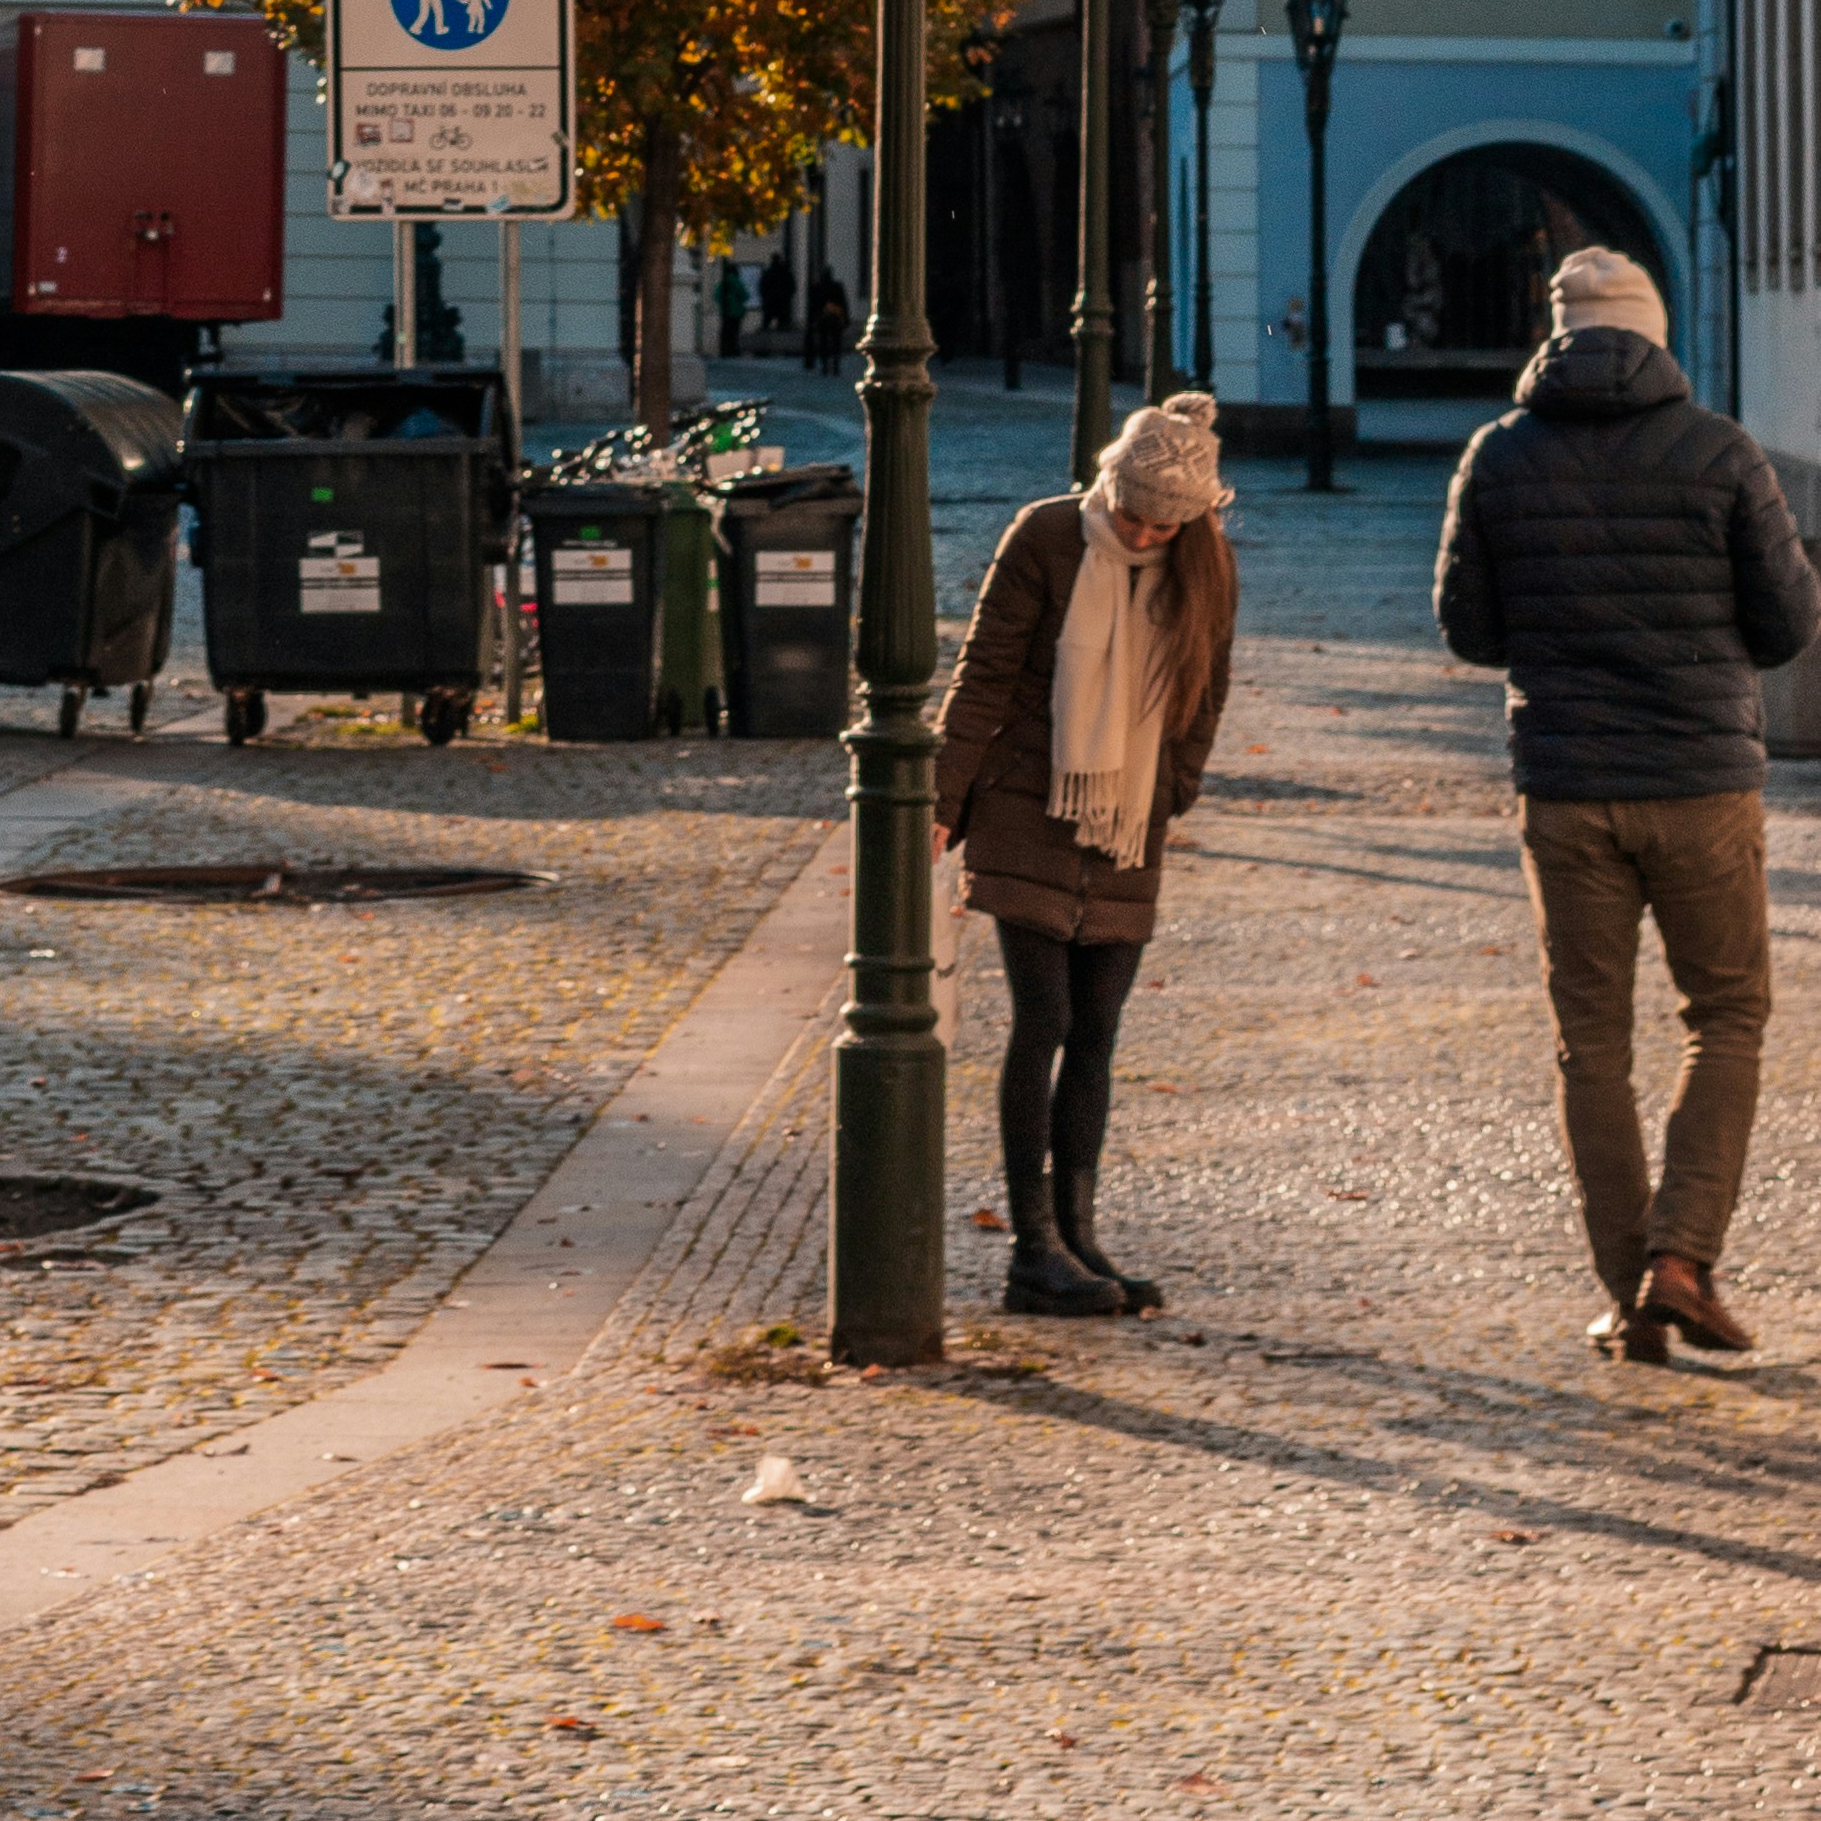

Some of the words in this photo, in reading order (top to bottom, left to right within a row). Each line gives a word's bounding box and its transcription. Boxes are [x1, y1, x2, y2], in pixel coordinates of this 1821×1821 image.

[367, 80, 446, 96] DOPRAVNÍ
[451, 82, 527, 96] OBSLUHA
[356, 103, 397, 117] MIMO
[403, 103, 435, 117] TAXI
[495, 103, 513, 117] 20
[529, 103, 546, 118] 22
[431, 180, 486, 194] PRAHA
